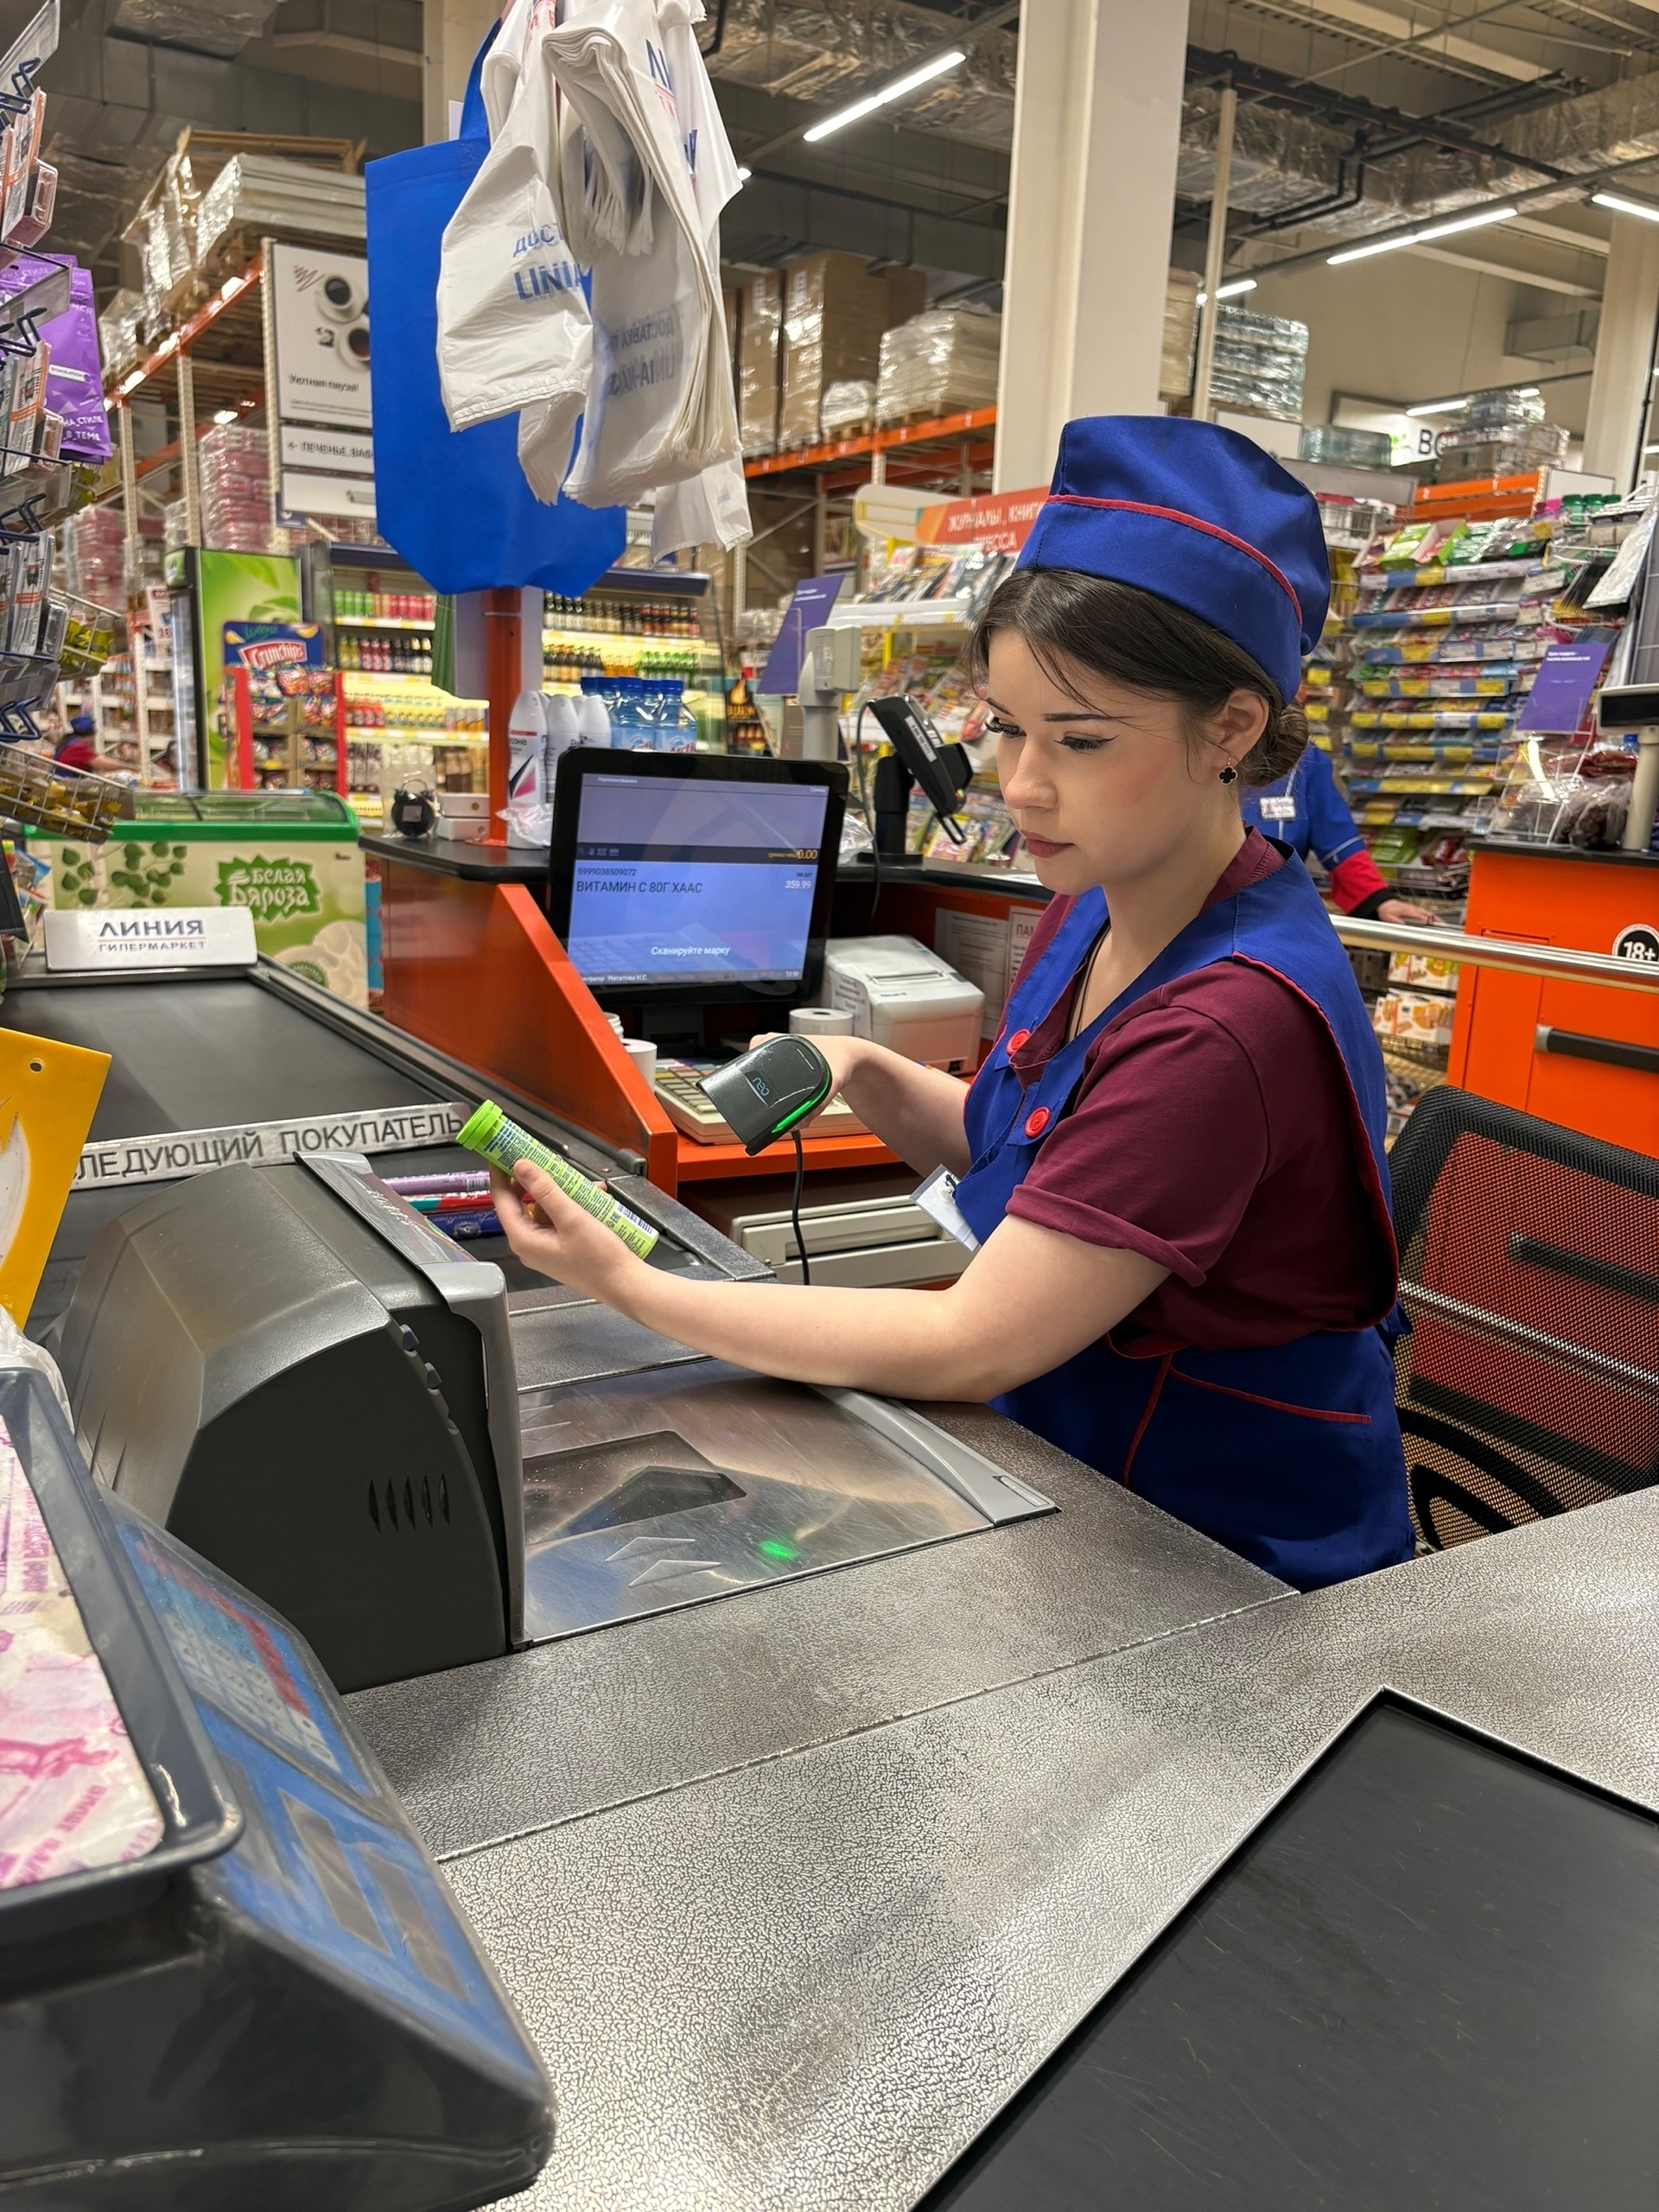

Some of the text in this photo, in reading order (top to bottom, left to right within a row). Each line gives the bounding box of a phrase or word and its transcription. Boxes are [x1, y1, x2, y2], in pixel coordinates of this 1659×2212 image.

[797, 849, 818, 860] 0.00
[577, 868, 637, 877] 5999038509072
[576, 880, 702, 893] ВИТАМИН С 80Г ХААС
[99, 919, 205, 938] ЛИНИЯ
[99, 940, 207, 952] ГИПЕРМАРКЕТ
[651, 945, 730, 957] Сканируйте марку
[1623, 940, 1656, 960] 18+
[73, 1110, 465, 1181] ЛЕДУЮЩИЙ ПОКУПАТЕЛЬ
